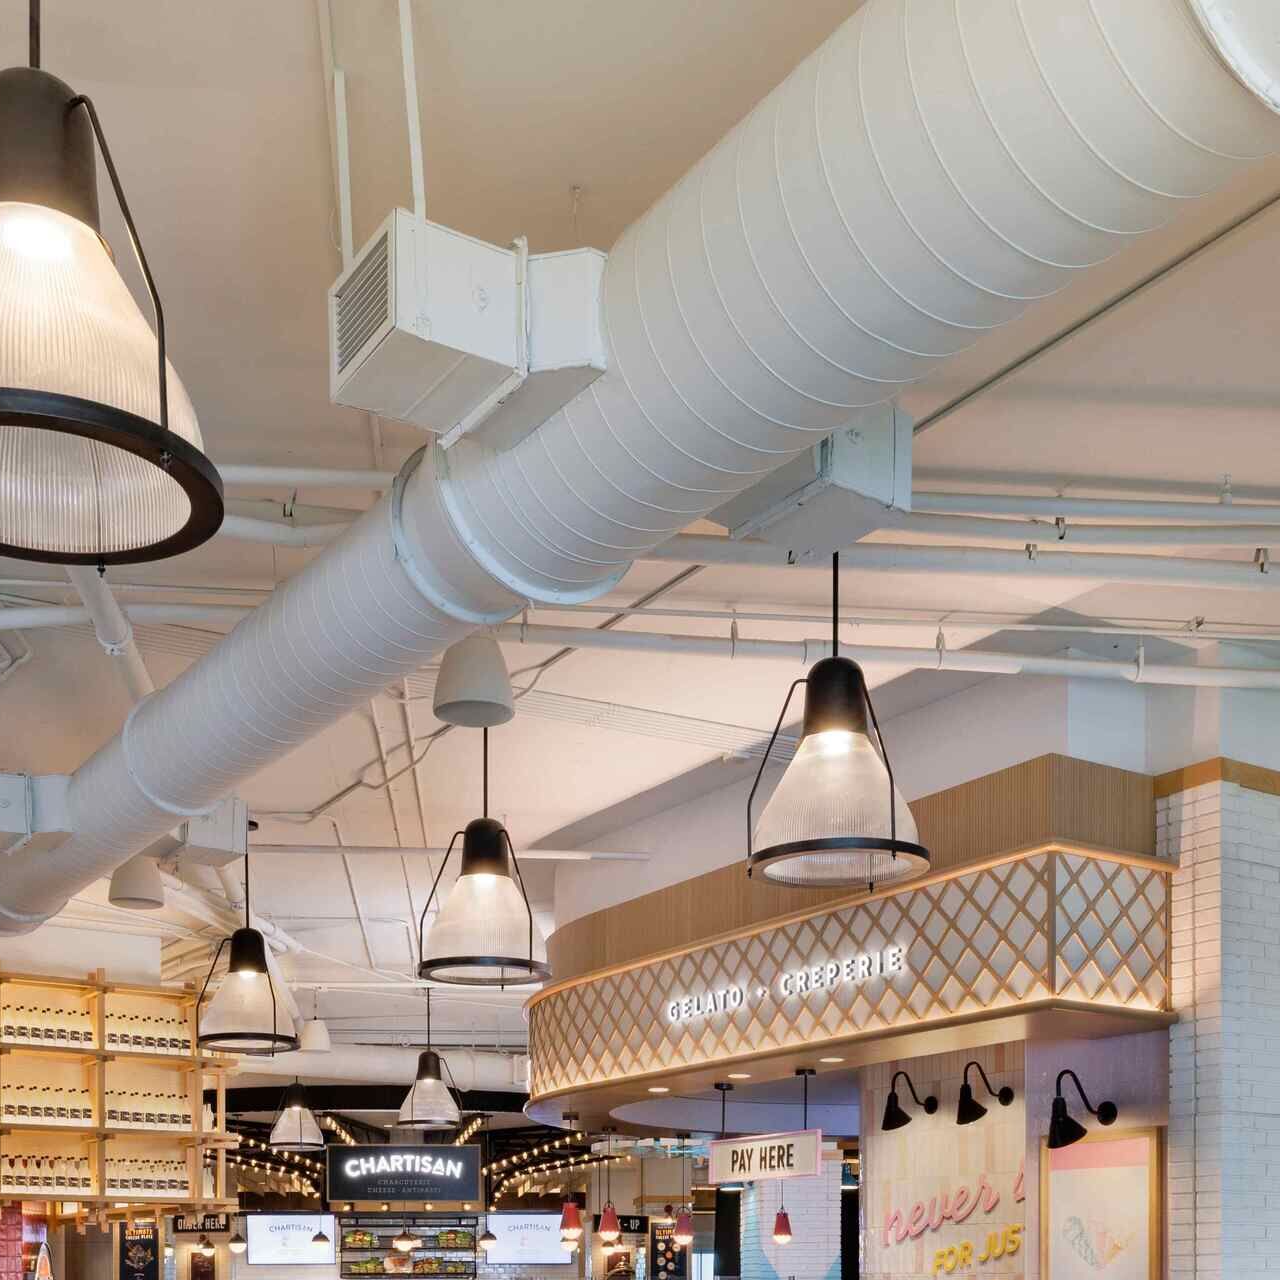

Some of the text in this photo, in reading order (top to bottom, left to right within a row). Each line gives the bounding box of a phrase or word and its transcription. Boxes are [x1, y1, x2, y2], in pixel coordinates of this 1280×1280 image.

[669, 986, 744, 1020] GELATO
[780, 948, 903, 996] CREPERIE
[344, 1154, 463, 1179] CHARTISAN
[731, 1143, 794, 1172] PAY HERE
[630, 1219, 640, 1230] UP
[883, 1175, 1000, 1248] never
[931, 1223, 1024, 1277] FOR JUS
